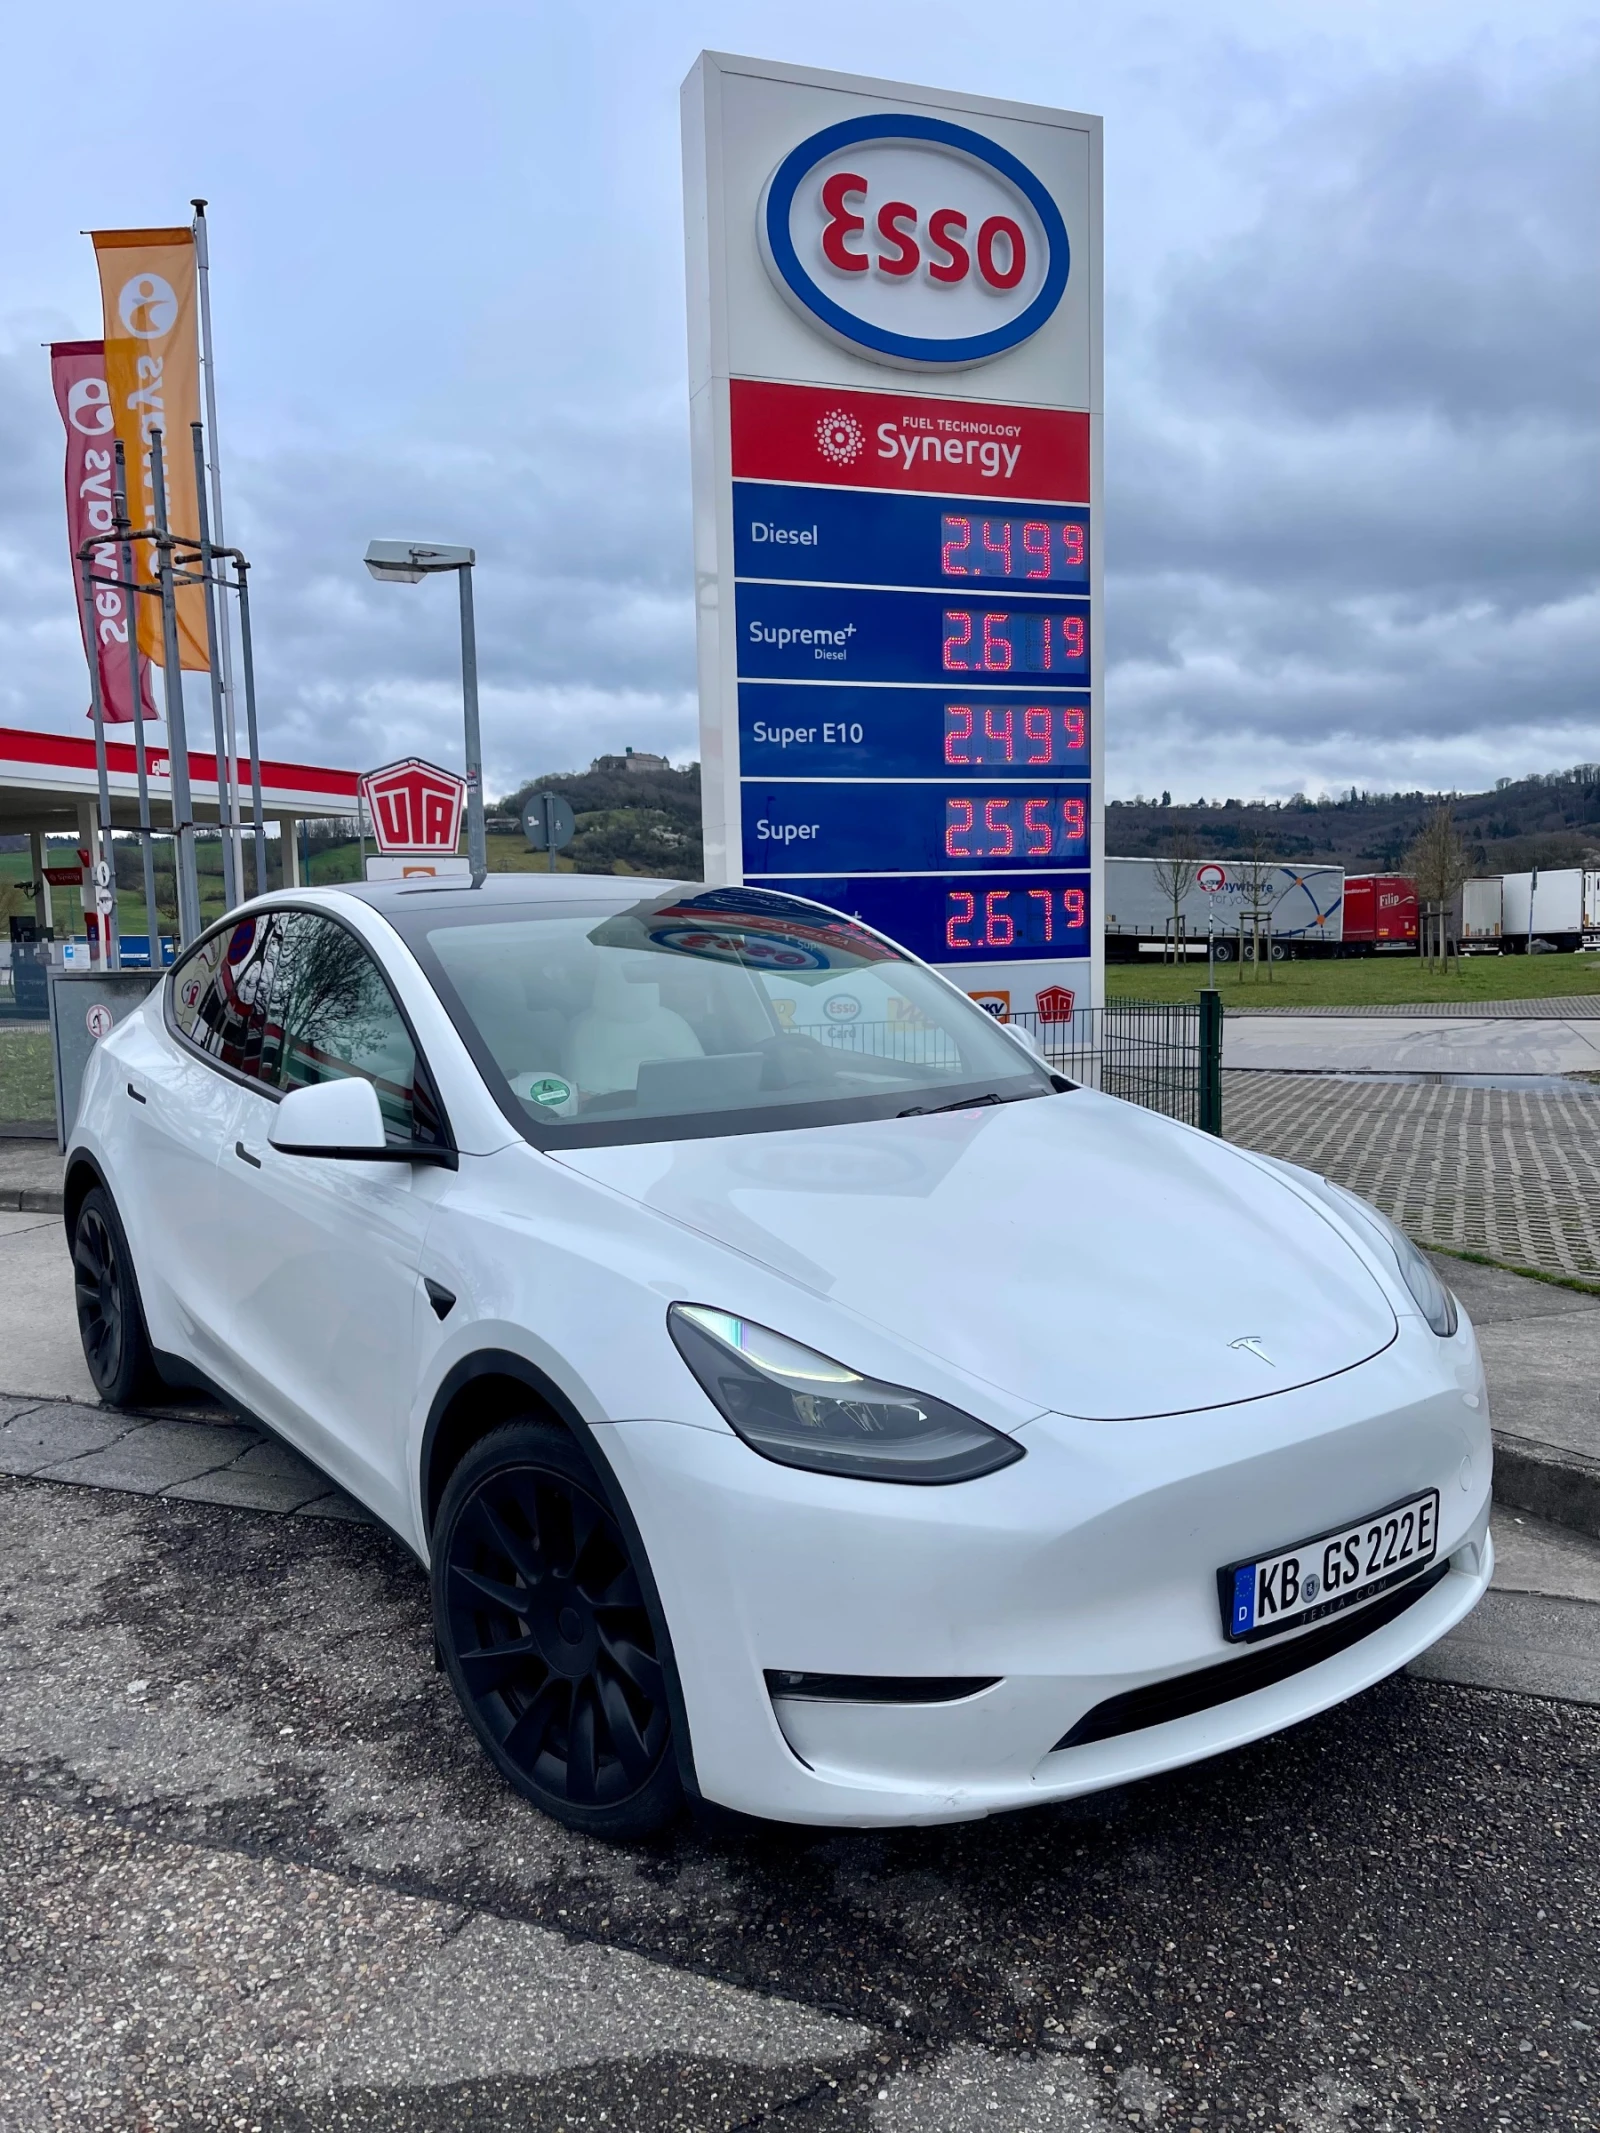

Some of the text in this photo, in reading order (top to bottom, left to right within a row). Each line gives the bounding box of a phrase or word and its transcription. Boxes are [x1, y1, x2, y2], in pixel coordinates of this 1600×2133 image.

[822, 172, 1026, 290] Esso
[902, 416, 1021, 438] FUEL TECHNOLOGY
[876, 422, 1022, 478] Synergy
[751, 521, 818, 546] Diesel
[814, 649, 847, 661] Diesel
[753, 721, 863, 748] Super E10
[756, 819, 820, 845] Super
[1380, 892, 1400, 908] Filip
[829, 1002, 857, 1014] Esso
[827, 1026, 856, 1039] Card
[1257, 1501, 1433, 1619] KB GS 222E
[1238, 1606, 1248, 1621] D
